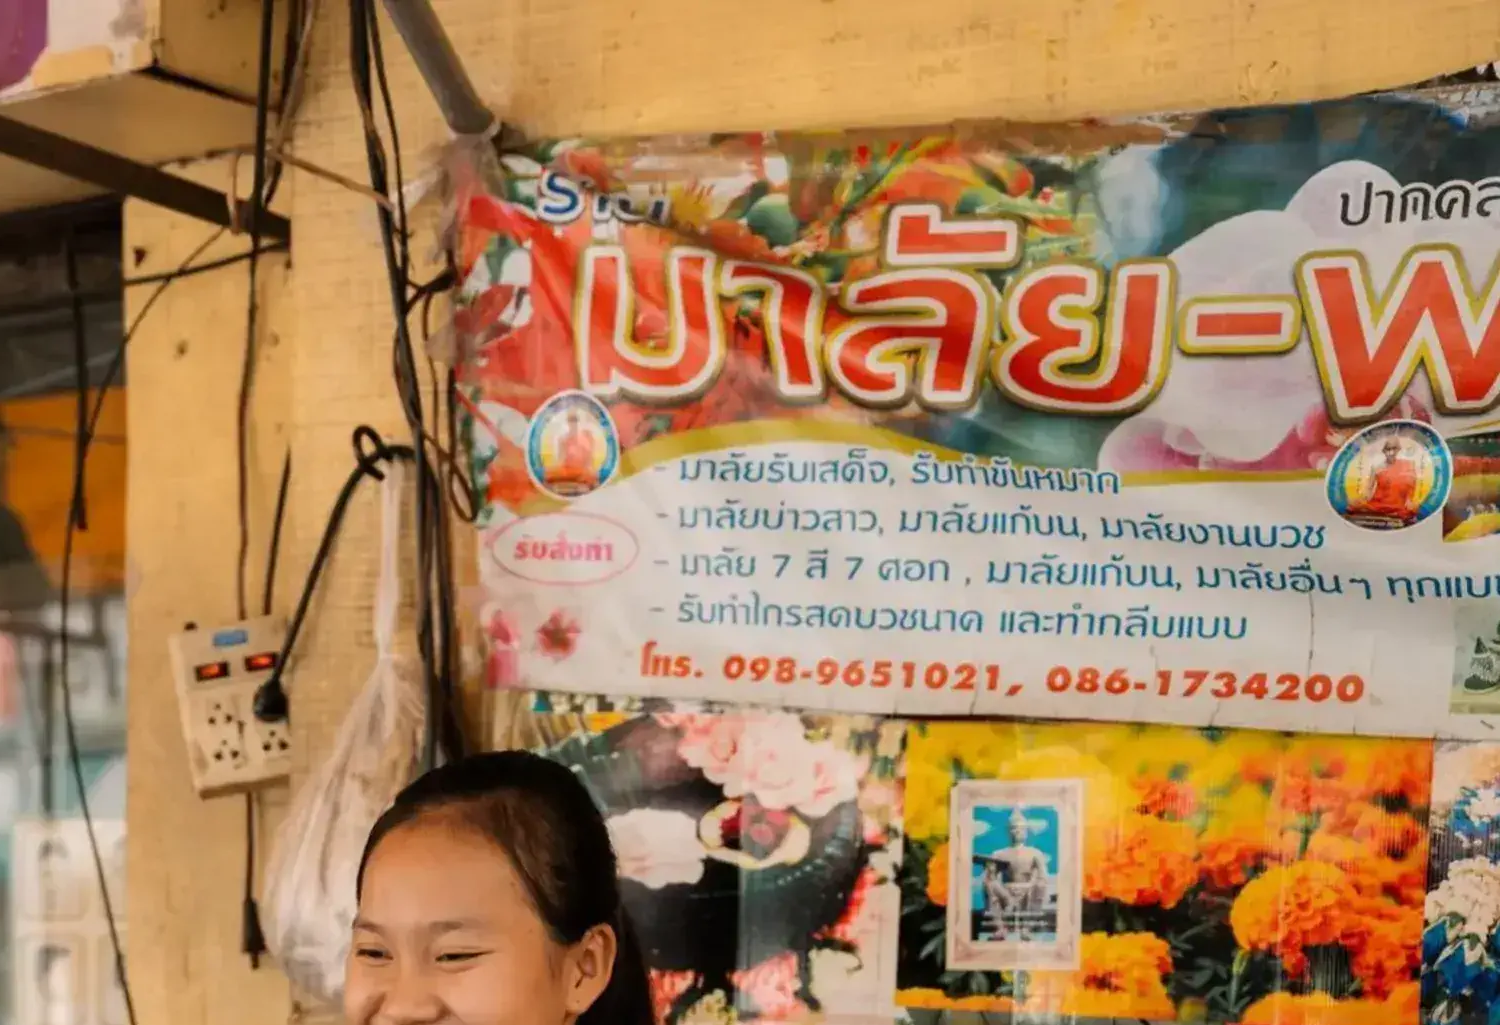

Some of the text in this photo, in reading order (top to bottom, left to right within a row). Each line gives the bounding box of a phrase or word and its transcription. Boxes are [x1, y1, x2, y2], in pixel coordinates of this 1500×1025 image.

[911, 453, 1120, 494] รับทำขันหมาก
[678, 498, 1326, 549] มาลัยบ่าวสาว, มาลัยแก้บน, มาลัยงานบวช
[679, 547, 757, 577] มาลัย
[772, 554, 792, 578] 7
[805, 549, 830, 580] สี
[844, 556, 864, 580] 7
[1386, 575, 1500, 603] ทุกแบ
[999, 603, 1248, 640] และทำกลีบแบบ
[640, 641, 1366, 703] โทร. 098-9651021, 086-1734200
